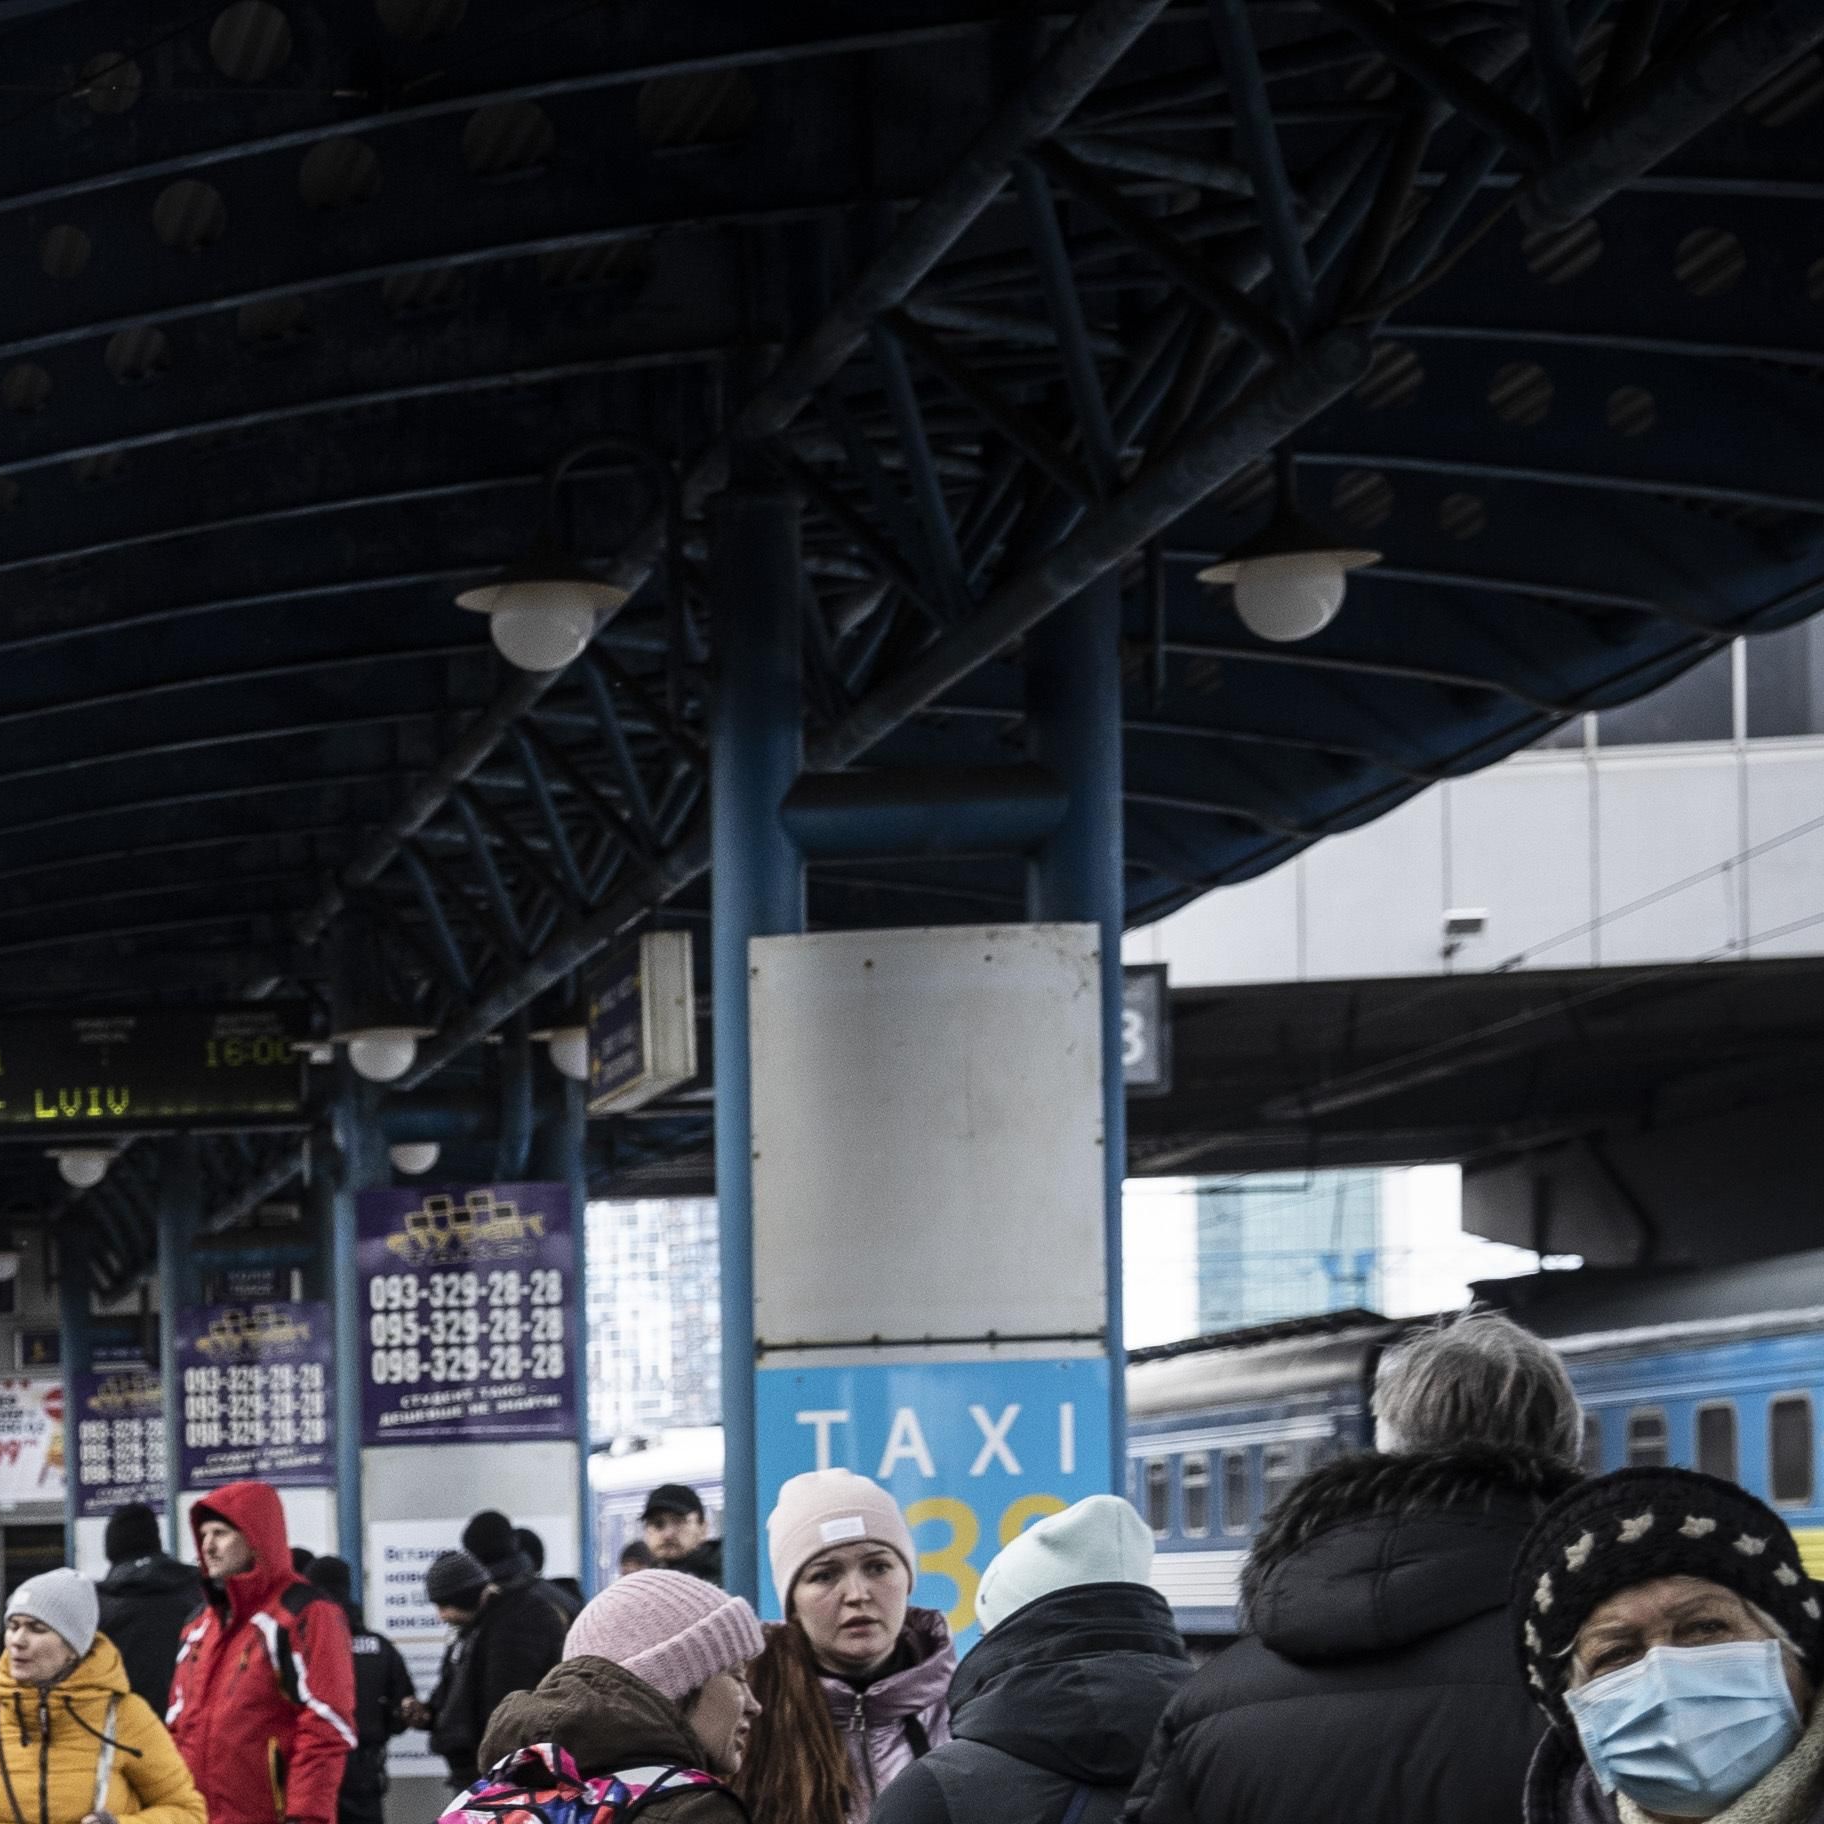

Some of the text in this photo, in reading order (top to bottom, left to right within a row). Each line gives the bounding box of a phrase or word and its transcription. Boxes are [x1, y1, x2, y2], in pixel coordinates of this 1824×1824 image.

[34, 1087, 130, 1118] LVIV
[370, 1269, 562, 1311] 093-329-28-28
[370, 1306, 563, 1347] 095-329-28-28
[371, 1343, 564, 1384] 098-329-28-28
[795, 1402, 1076, 1479] TAXI
